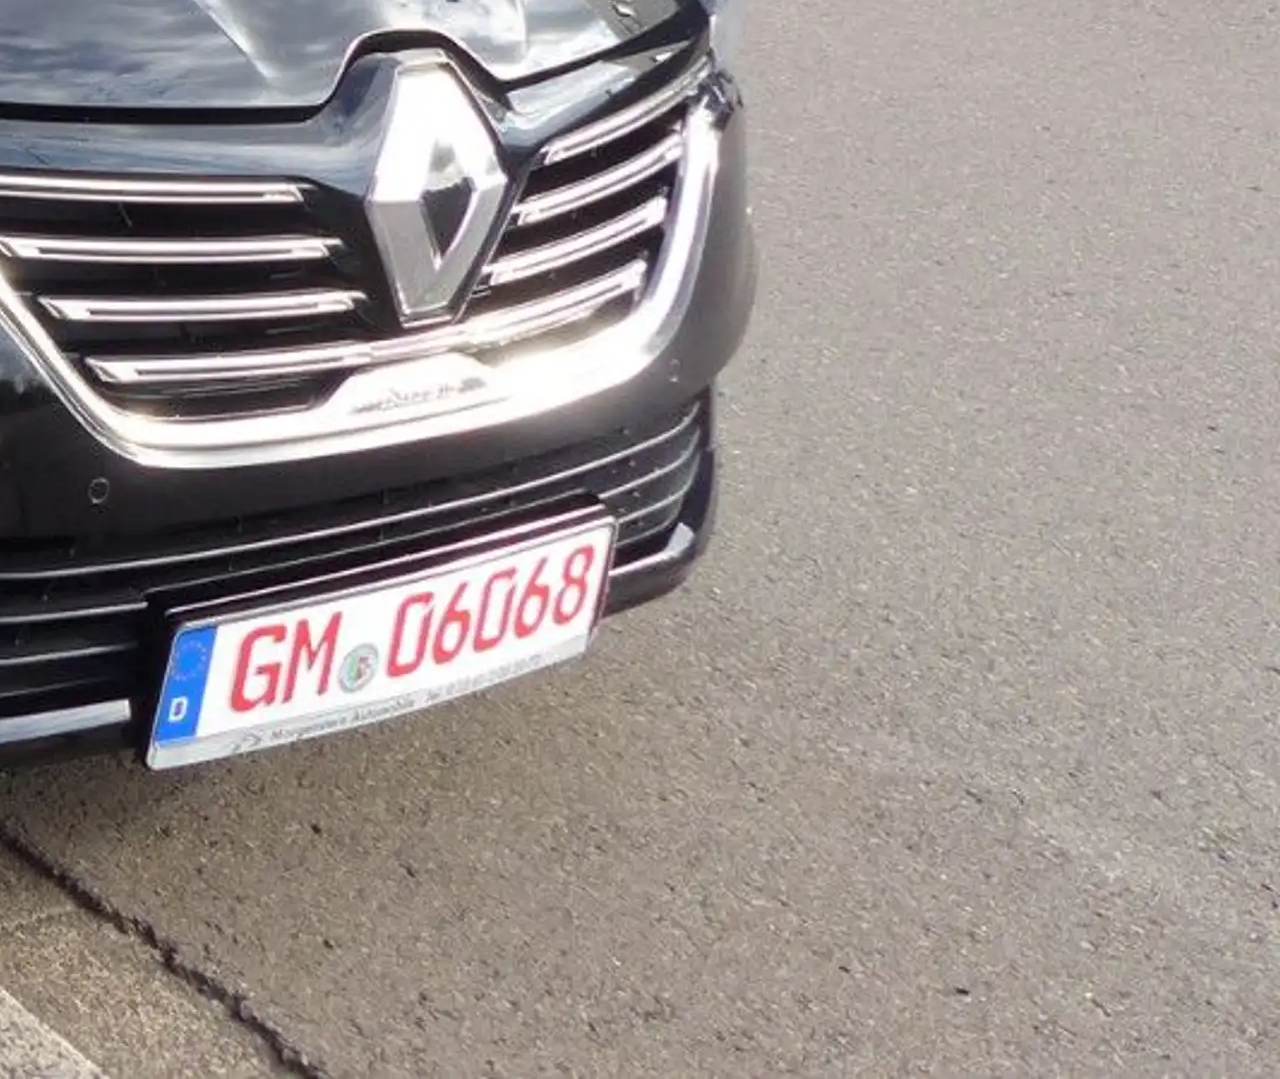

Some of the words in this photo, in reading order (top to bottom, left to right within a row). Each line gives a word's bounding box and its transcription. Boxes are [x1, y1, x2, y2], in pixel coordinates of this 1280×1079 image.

[230, 611, 342, 712] GM
[386, 545, 594, 678] 06068
[168, 696, 188, 722] D
